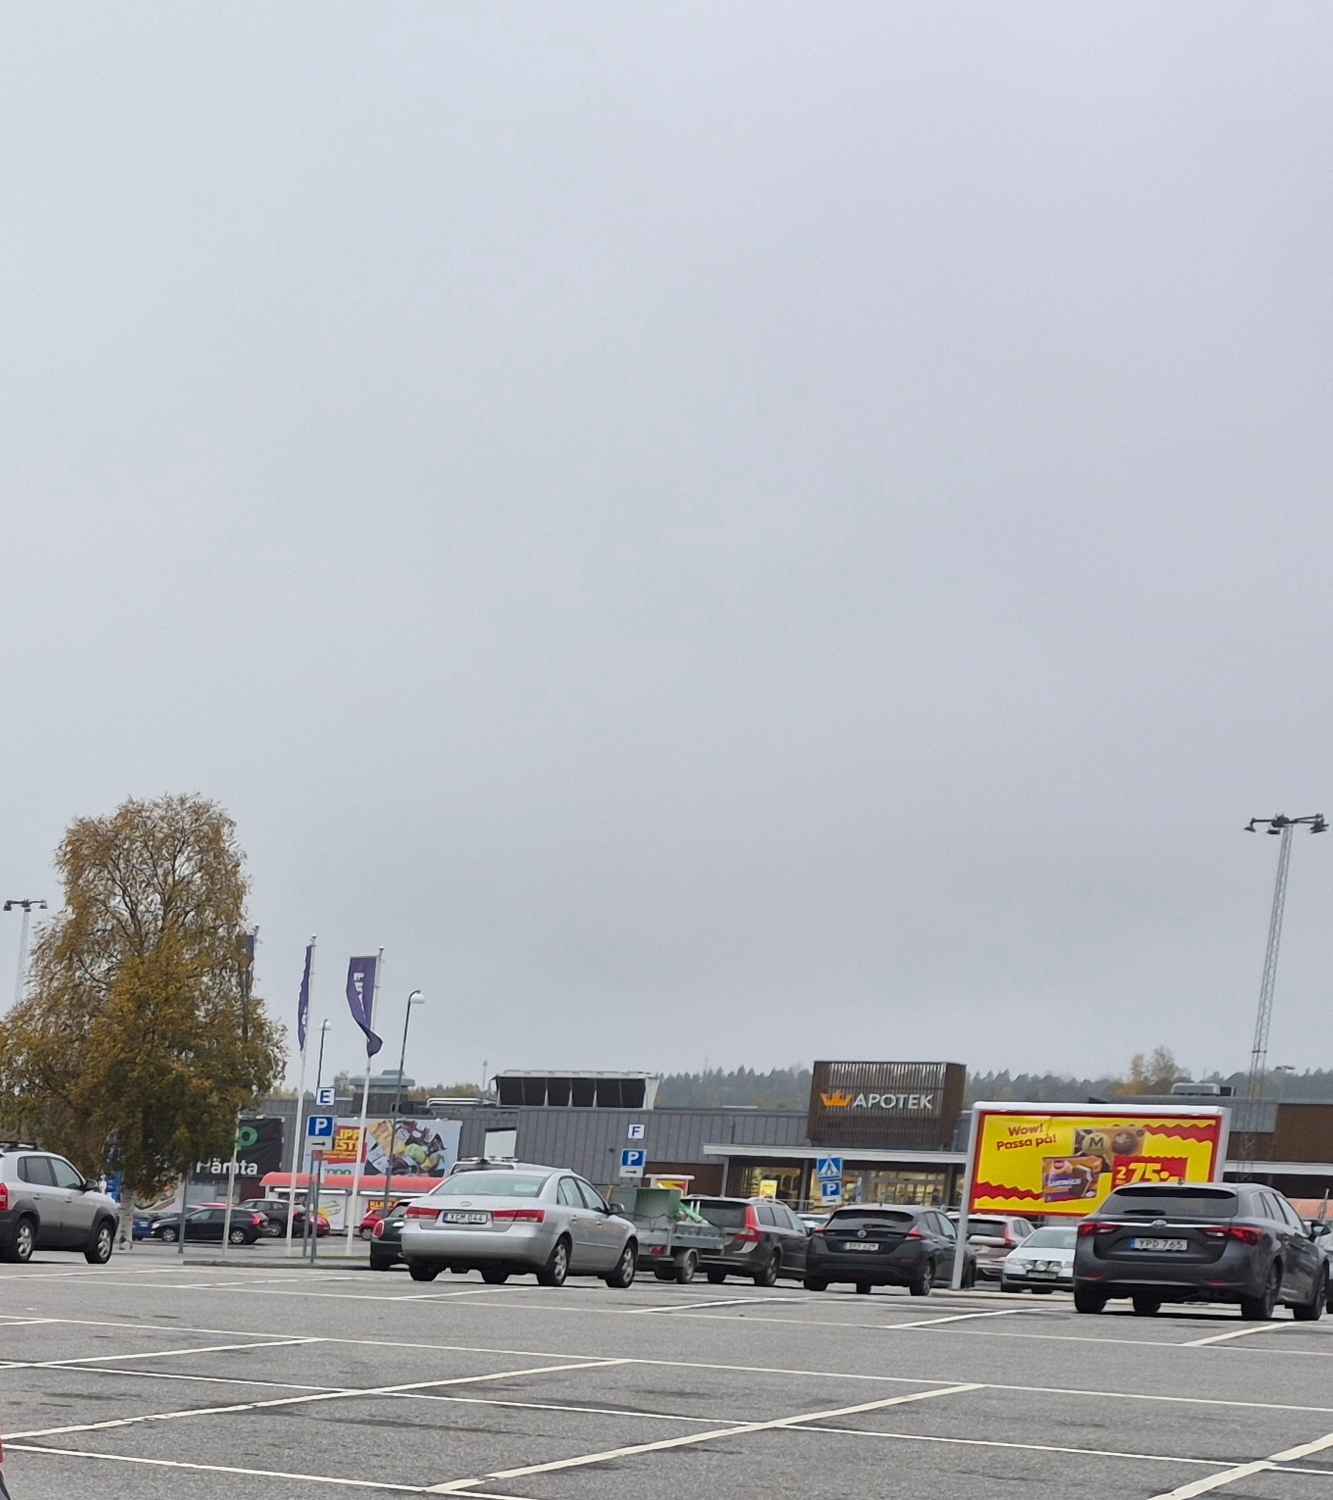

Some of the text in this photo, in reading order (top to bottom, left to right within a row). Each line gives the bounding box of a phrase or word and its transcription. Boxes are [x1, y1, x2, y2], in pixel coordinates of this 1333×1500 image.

[320, 1090, 331, 1103] E
[852, 1092, 934, 1109] APOTEK
[315, 1119, 327, 1135] P
[632, 1126, 641, 1136] F
[1008, 1123, 1043, 1137] Wow!
[997, 1133, 1056, 1151] Passa på!
[1090, 1137, 1104, 1148] M
[627, 1152, 639, 1165] P
[196, 1158, 258, 1175] Hämta
[1117, 1166, 1126, 1178] 2
[827, 1184, 836, 1195] P
[1139, 1239, 1183, 1248] YPD 765
